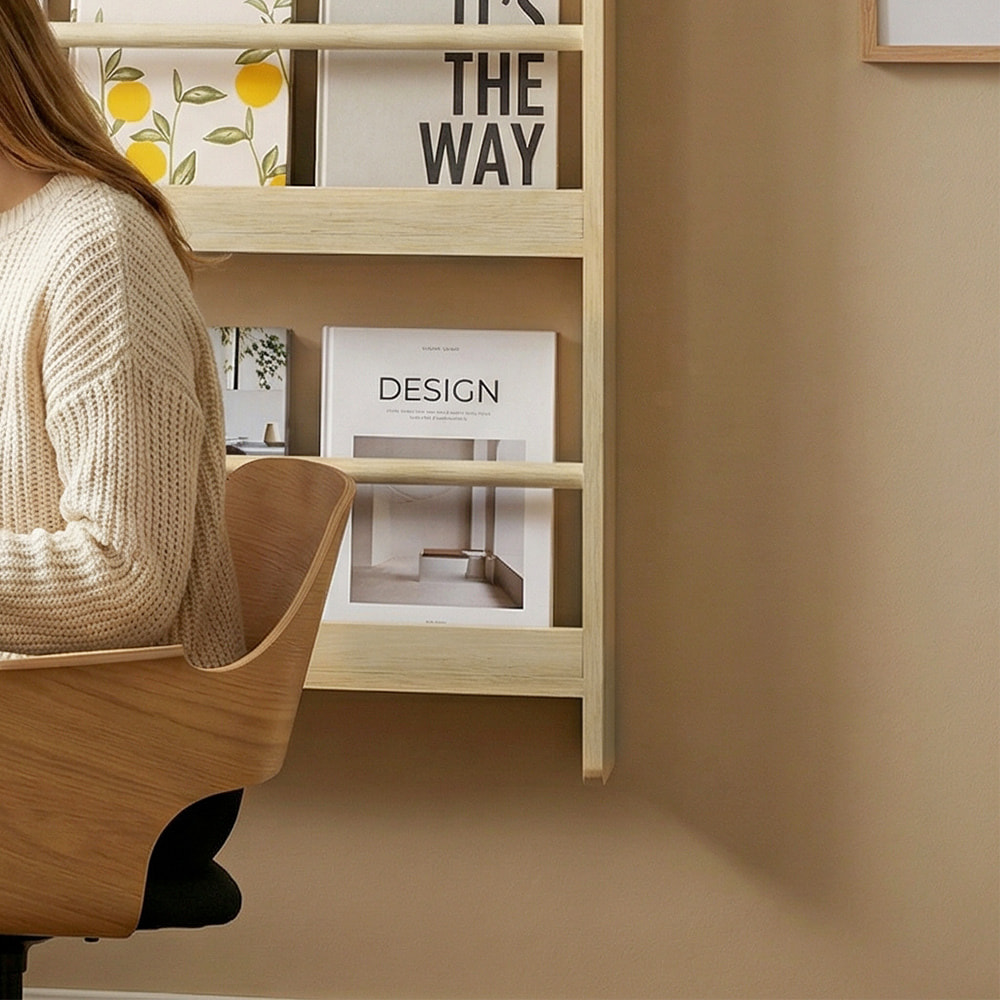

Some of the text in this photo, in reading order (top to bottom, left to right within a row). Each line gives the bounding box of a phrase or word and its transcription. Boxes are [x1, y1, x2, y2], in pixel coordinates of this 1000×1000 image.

[444, 52, 545, 116] THE
[419, 122, 545, 186] WAY
[379, 376, 499, 404] DESIGN
